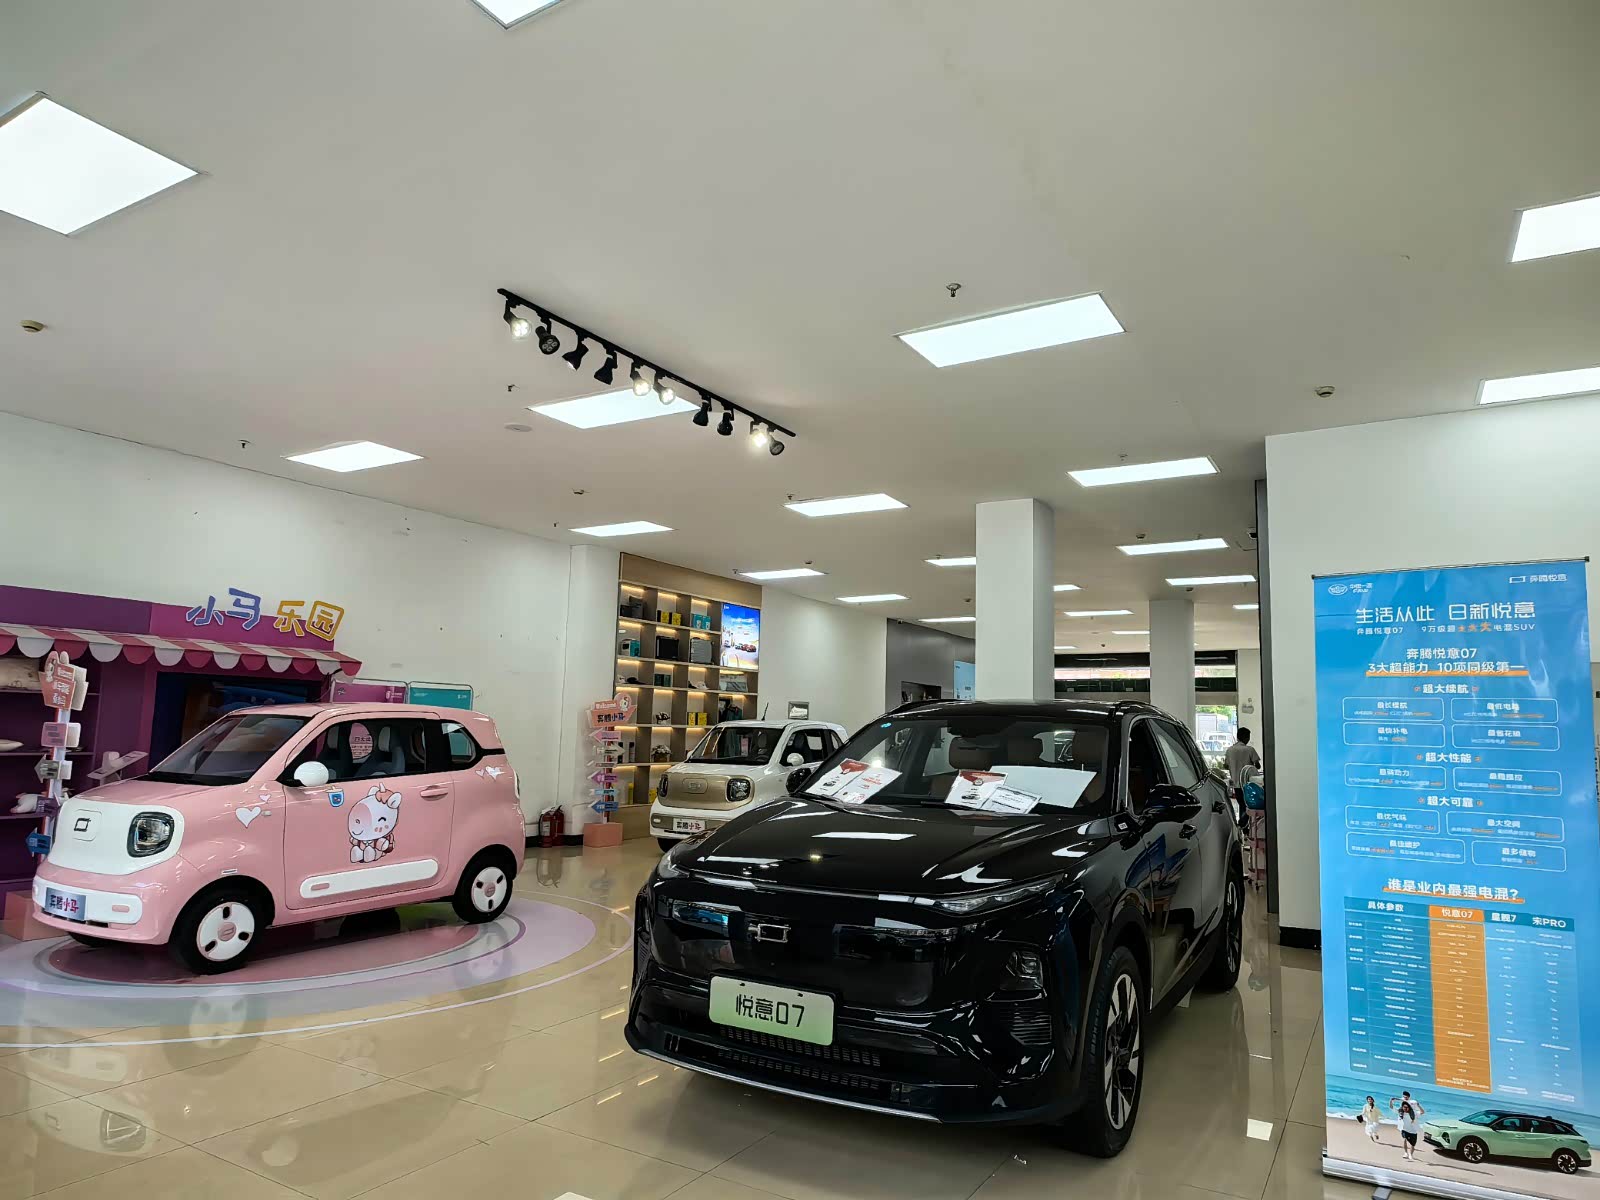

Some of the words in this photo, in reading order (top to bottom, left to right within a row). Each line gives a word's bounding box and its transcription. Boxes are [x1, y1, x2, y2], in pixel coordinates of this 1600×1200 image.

[1355, 604, 1436, 624] 生活从此
[1448, 601, 1536, 621] 日新悦意
[1356, 626, 1404, 636] 奔腾悦意07
[1406, 647, 1478, 660] 奔腾悦意07
[1367, 661, 1429, 675] 3大超能力
[1437, 660, 1526, 674] 10项同级第一
[1422, 683, 1469, 694] 超大续航
[1425, 752, 1472, 763] 超大性能
[1426, 795, 1474, 808] 超大可靠
[1367, 900, 1404, 912] 具体参数
[1441, 908, 1474, 919] 悦意07
[735, 993, 806, 1028] 悦意07
